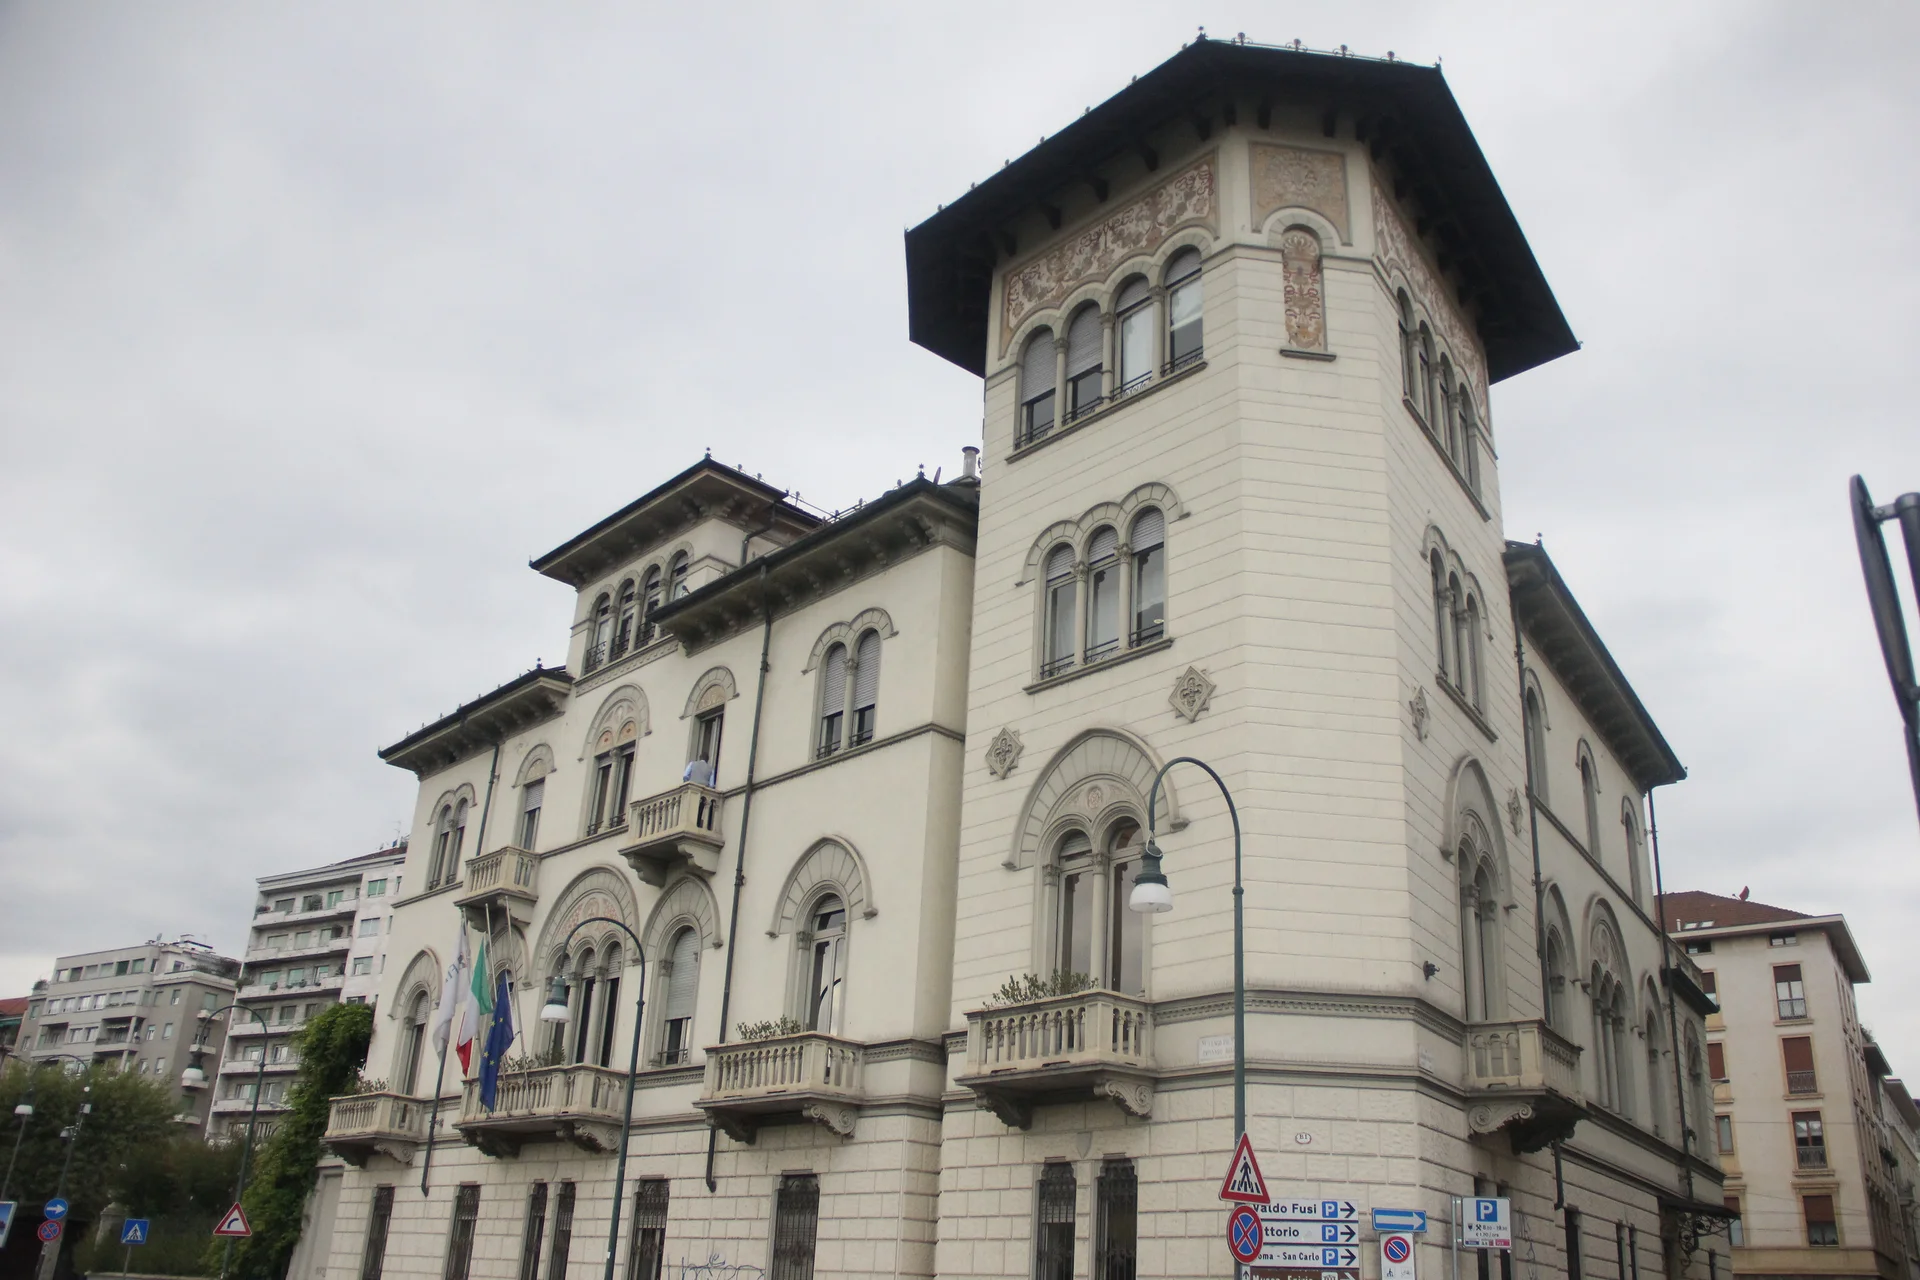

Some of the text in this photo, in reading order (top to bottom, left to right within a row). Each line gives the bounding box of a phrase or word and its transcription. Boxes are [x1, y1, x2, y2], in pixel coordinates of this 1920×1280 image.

[1292, 1204, 1317, 1214] Fusi
[1264, 1226, 1300, 1237] ttorio
[1282, 1252, 1296, 1260] San
[1298, 1252, 1320, 1260] Carlo
